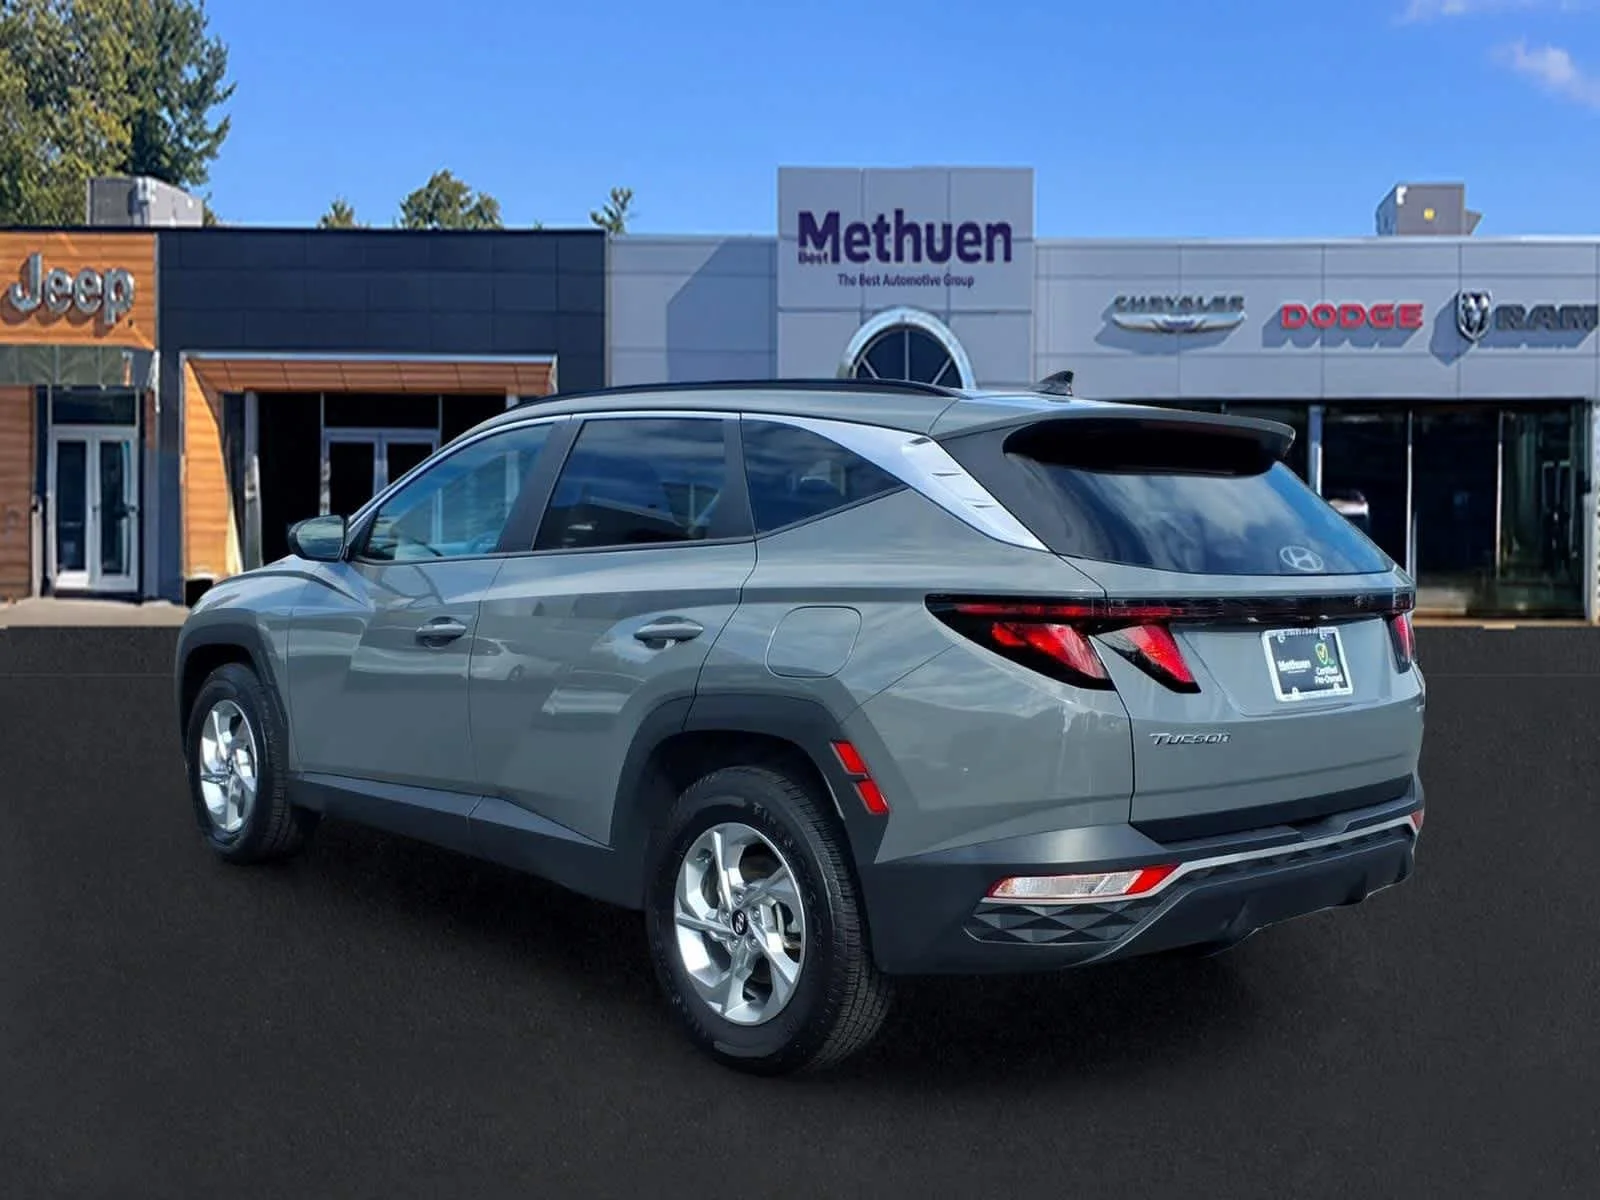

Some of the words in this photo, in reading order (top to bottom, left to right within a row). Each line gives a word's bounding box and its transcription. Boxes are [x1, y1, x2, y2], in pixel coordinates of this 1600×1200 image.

[798, 208, 1012, 264] Methuen
[10, 252, 134, 325] Jeep
[838, 273, 857, 286] The
[859, 273, 880, 286] Best
[883, 273, 941, 286] Automotive
[943, 273, 974, 288] Group
[1114, 295, 1244, 312] CHRYSLER
[1280, 303, 1424, 329] DODGE
[1495, 303, 1599, 330] RAM
